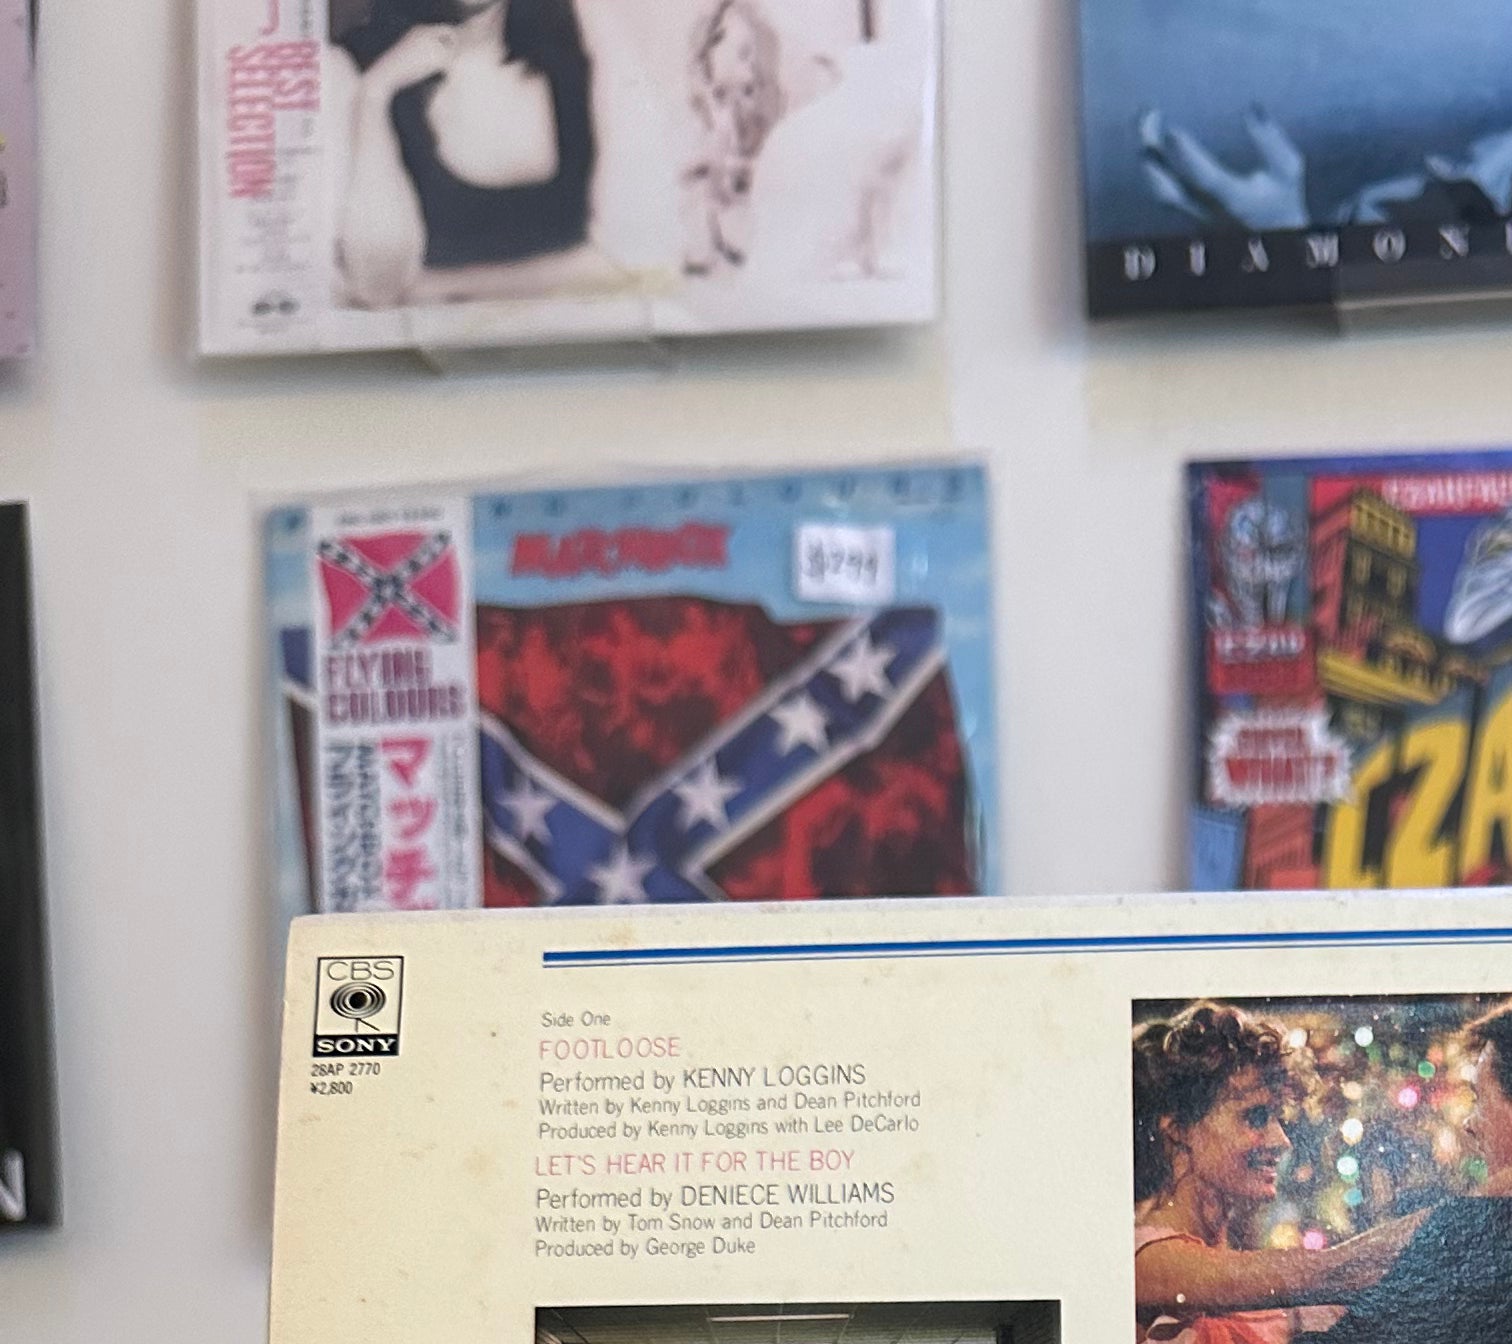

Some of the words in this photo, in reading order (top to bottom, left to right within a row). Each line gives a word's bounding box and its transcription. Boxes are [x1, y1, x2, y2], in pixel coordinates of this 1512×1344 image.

[326, 960, 395, 981] CBS
[541, 1011, 574, 1028] Side
[580, 1010, 611, 1027] One
[316, 1037, 396, 1053] SONY
[538, 1036, 681, 1061] FOOTLOOSE
[310, 1062, 345, 1078] 28AP
[348, 1061, 381, 1077] 2770
[539, 1070, 645, 1093] Performed
[653, 1070, 676, 1094] by
[682, 1066, 756, 1089] KENNY
[763, 1063, 867, 1087] LOGGINS
[538, 1098, 599, 1116] Written
[604, 1097, 625, 1118] by
[630, 1096, 681, 1117] Kenny
[686, 1095, 751, 1116] Loggins
[755, 1093, 788, 1112] and
[794, 1091, 838, 1110] Dean
[842, 1090, 921, 1109] Pitchford
[534, 1153, 596, 1177] LET'S
[606, 1152, 666, 1175] HEAR
[674, 1151, 694, 1173] IT
[701, 1150, 748, 1173] FOR
[755, 1150, 801, 1172] THE
[809, 1148, 855, 1171] BOY
